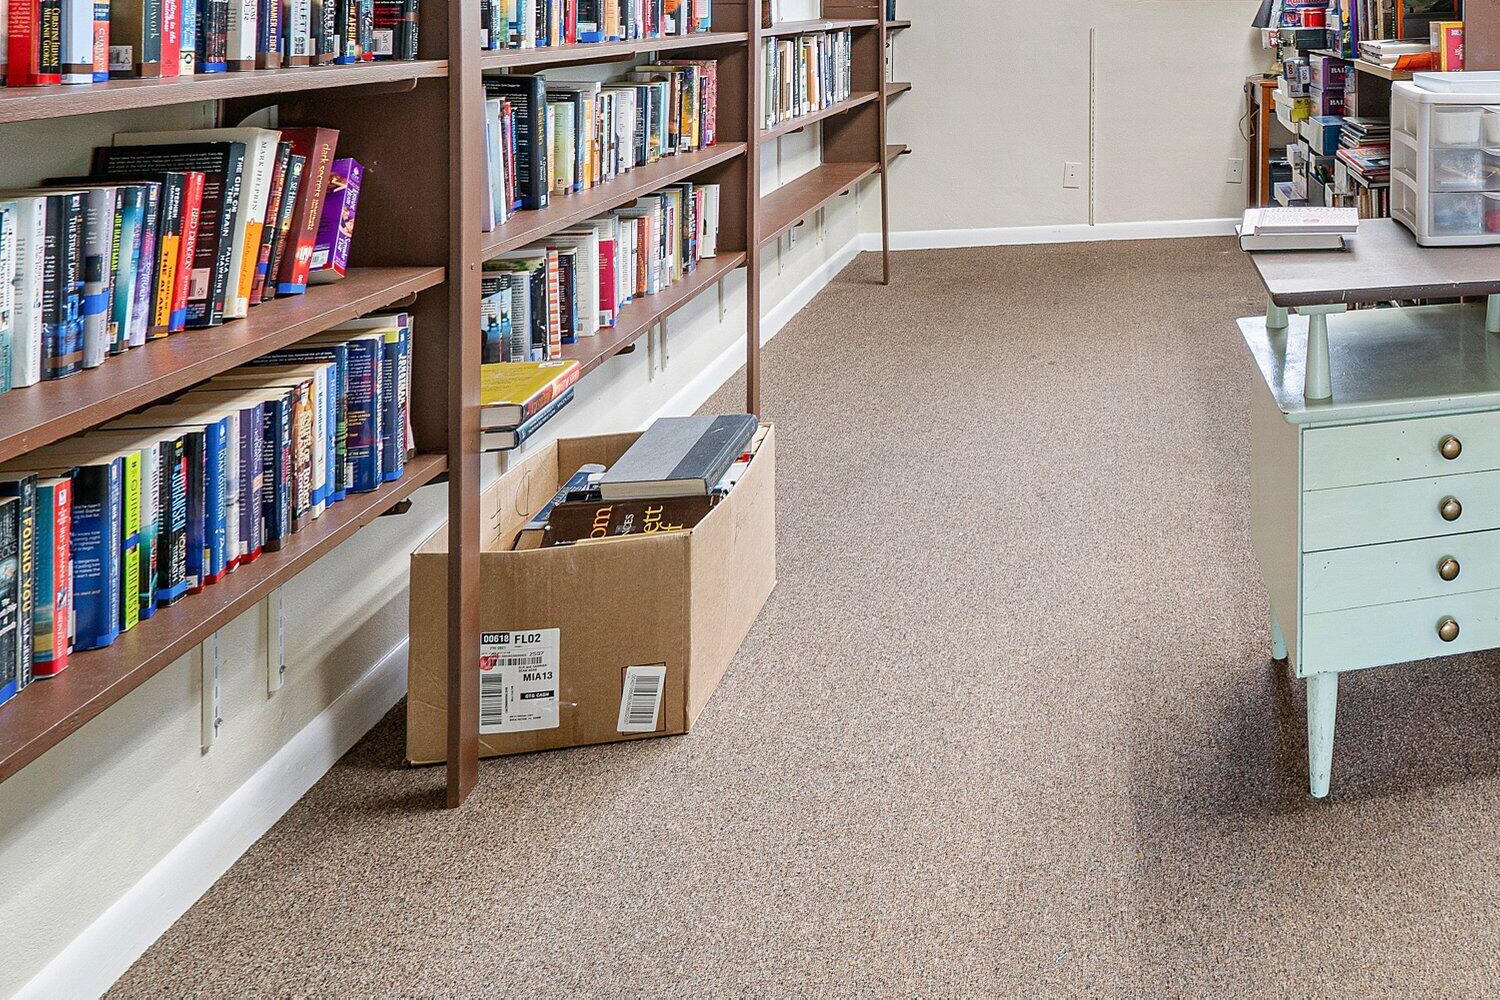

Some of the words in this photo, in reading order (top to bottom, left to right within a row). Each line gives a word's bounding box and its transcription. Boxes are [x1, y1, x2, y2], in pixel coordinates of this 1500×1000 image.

[258, 141, 268, 166] MARK
[191, 207, 199, 225] RED
[223, 205, 232, 237] TRAIN
[110, 227, 122, 271] HALDEMAN
[185, 228, 198, 271] DRAGON
[216, 255, 225, 294] HAWKINS
[171, 466, 187, 533] JOHANSEN
[21, 518, 32, 574] FOUND
[21, 581, 31, 613] YOU
[483, 634, 509, 643] 00618
[514, 634, 541, 644] FL02
[523, 671, 553, 682] MIA13
